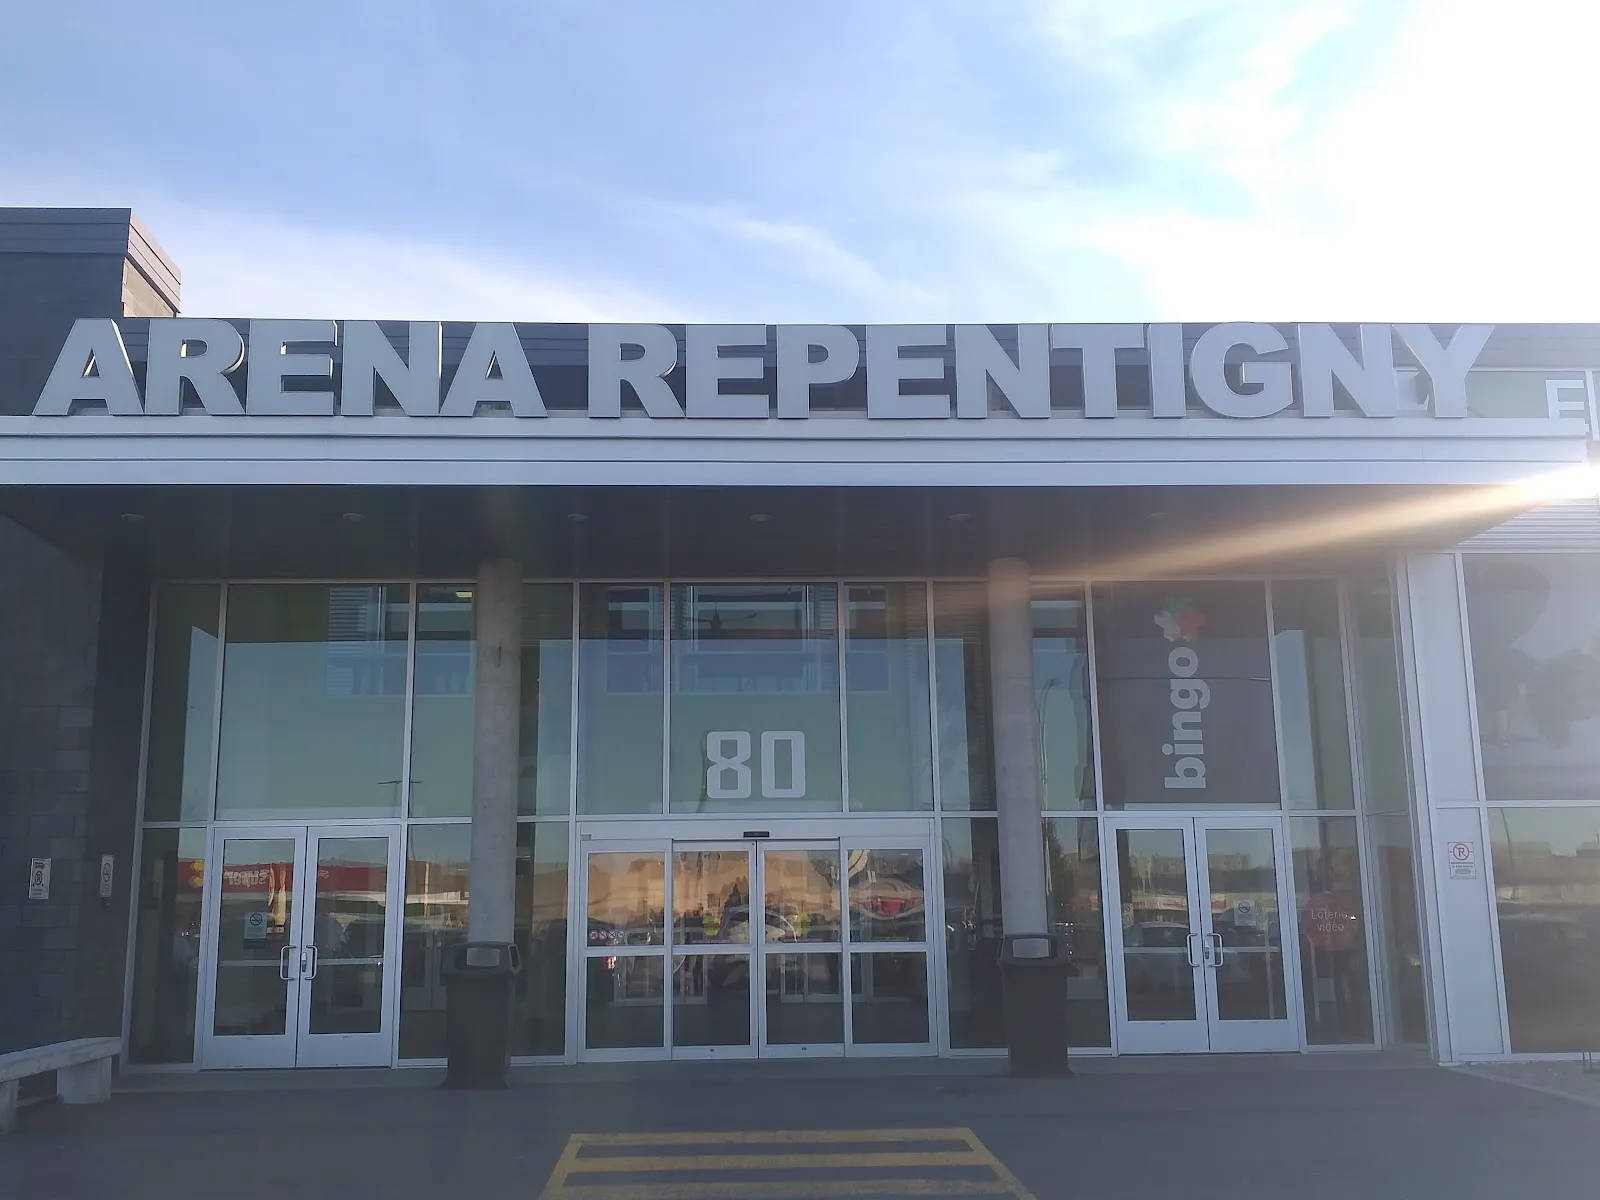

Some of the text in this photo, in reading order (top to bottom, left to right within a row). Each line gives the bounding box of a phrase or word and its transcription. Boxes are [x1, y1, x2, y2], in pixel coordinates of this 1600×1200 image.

[32, 316, 1496, 419] ARENA REPENTIGNY
[1162, 646, 1211, 788] bingo
[706, 730, 806, 798] 80
[1311, 909, 1348, 920] Loterie
